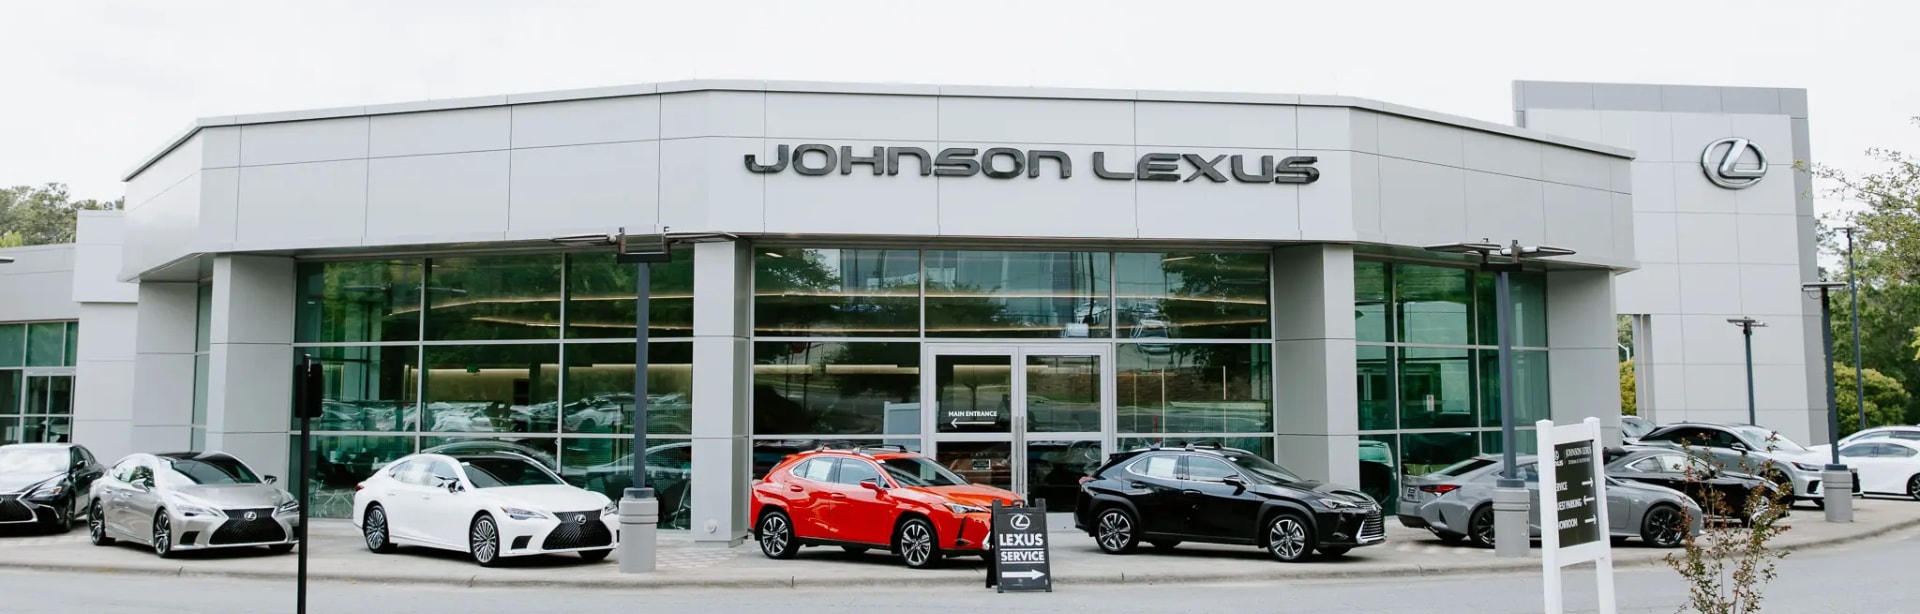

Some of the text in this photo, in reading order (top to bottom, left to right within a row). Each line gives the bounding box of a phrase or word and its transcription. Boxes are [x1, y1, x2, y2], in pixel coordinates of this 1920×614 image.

[744, 143, 1320, 185] JOHNSON LEXUS
[999, 533, 1043, 546] LEXUS
[1001, 551, 1045, 561] SERVICE
